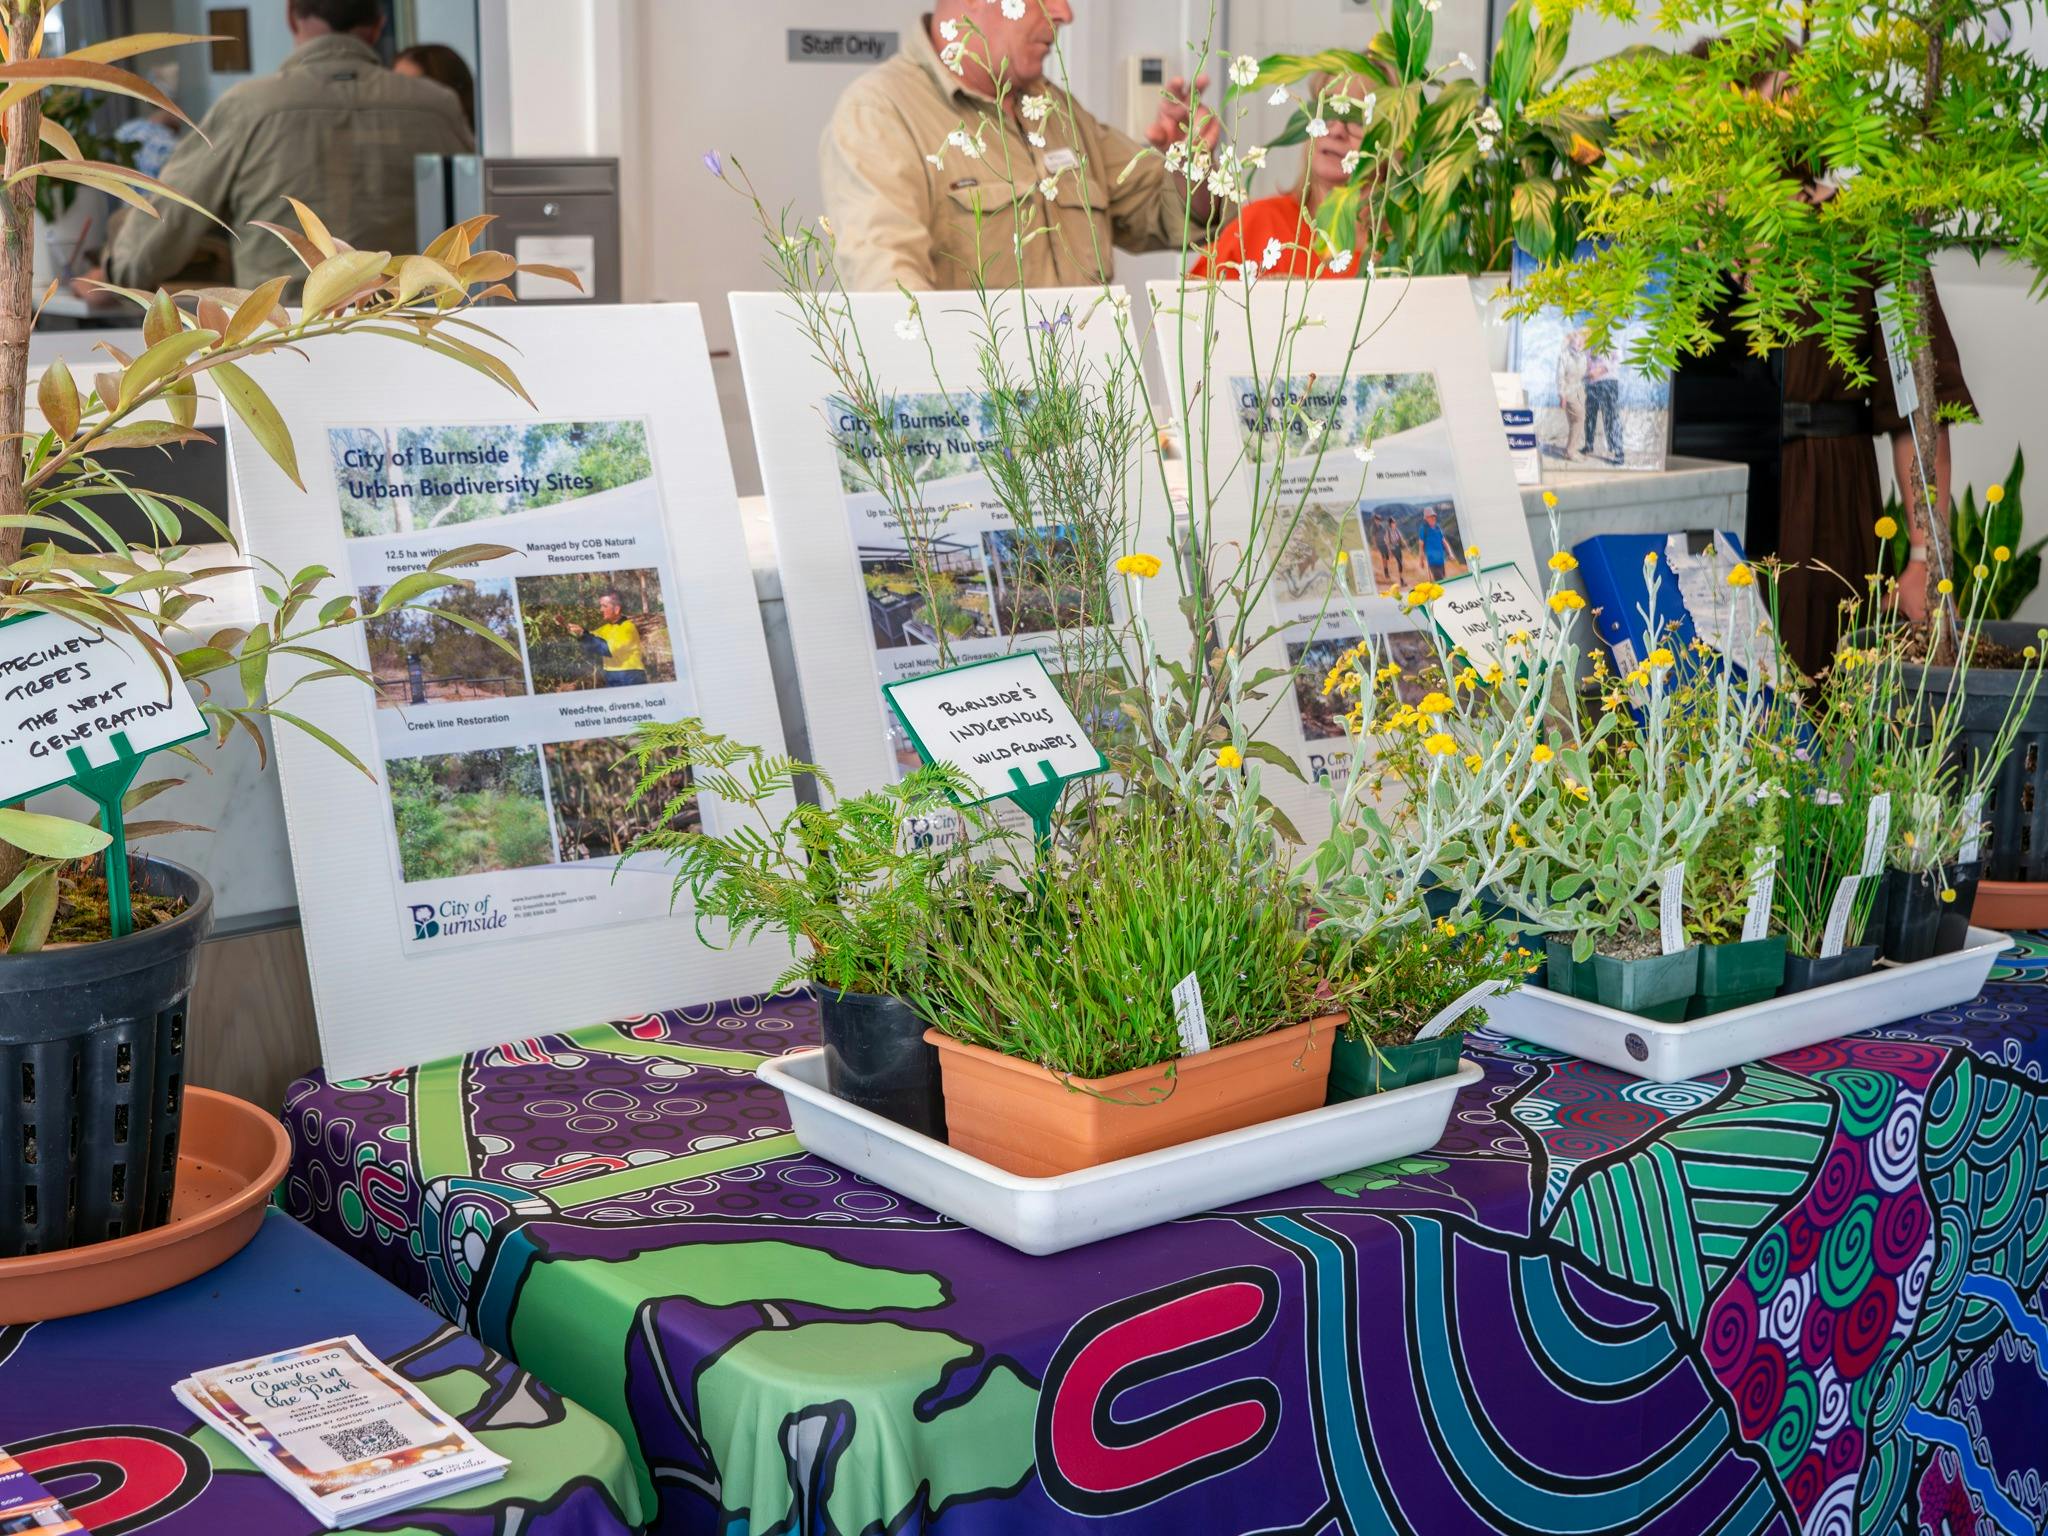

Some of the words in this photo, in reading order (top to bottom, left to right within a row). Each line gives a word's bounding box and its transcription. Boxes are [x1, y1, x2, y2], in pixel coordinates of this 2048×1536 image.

[801, 35, 844, 54] Staff
[846, 35, 886, 59] Only
[1271, 391, 1286, 406] of
[899, 410, 970, 429] Burnside
[946, 437, 1004, 454] Nurser
[344, 449, 385, 472] City
[391, 446, 413, 466] of
[420, 445, 509, 465] Burnside
[349, 479, 413, 499] Urban
[420, 474, 540, 498] Biodiversity
[546, 472, 594, 491] Sites
[866, 509, 877, 518] Up
[991, 511, 1009, 520] Face
[385, 550, 404, 559] 12.5
[406, 549, 418, 558] ha
[526, 541, 567, 552] Managed
[569, 540, 580, 550] by
[582, 538, 602, 548] COB
[604, 536, 636, 547] Natural
[387, 563, 427, 573] reserves
[547, 553, 595, 563] Resources
[596, 550, 620, 560] Team
[1448, 582, 1515, 615] BURNDE'S
[1463, 609, 1533, 637] INDINOUS
[894, 660, 915, 670] Local
[5, 662, 91, 702] TREES
[18, 708, 58, 733] THE
[67, 681, 127, 714] NEXT
[559, 703, 607, 716] Weed-free,
[609, 701, 643, 714] diverse,
[645, 698, 666, 708] local
[938, 681, 1037, 717] BURNSIDE'S
[30, 697, 173, 758] GENERATION
[407, 719, 435, 731] Creek
[437, 718, 454, 729] line
[457, 713, 510, 727] Restoration
[575, 717, 601, 728] native
[604, 712, 656, 727] landscapes.
[949, 708, 1054, 743] INDIGENOUS
[440, 900, 469, 919] City
[474, 894, 491, 915] of
[225, 1369, 271, 1385] YOU'RE
[274, 1357, 321, 1374] INVITED
[324, 1353, 340, 1361] TO
[251, 1371, 318, 1397] Carols
[321, 1367, 345, 1380] in
[264, 1395, 301, 1409] the
[300, 1378, 359, 1400] Park
[290, 1409, 317, 1418] FRIDAY
[327, 1395, 368, 1409] DECEMBER
[297, 1406, 347, 1422] HAZELWOOD
[350, 1400, 369, 1408] PARK
[278, 1423, 322, 1437] FOLLOWED
[336, 1408, 375, 1421] OUTDOOR
[377, 1400, 403, 1410] MOVIE
